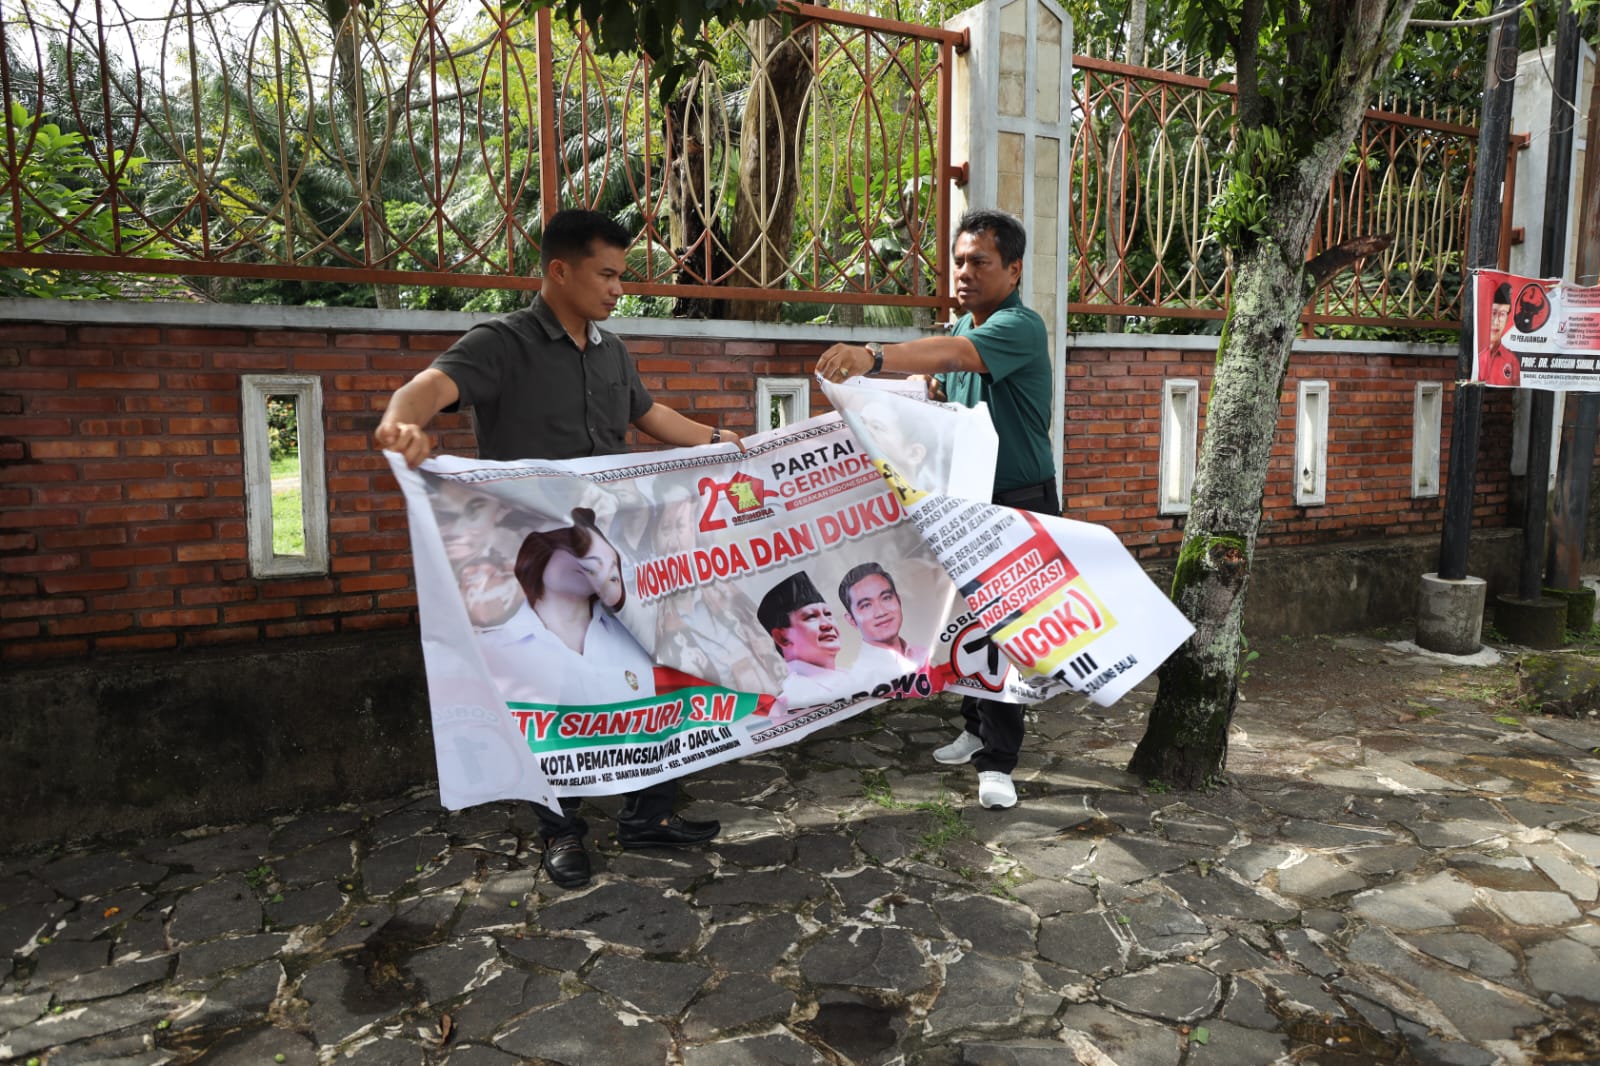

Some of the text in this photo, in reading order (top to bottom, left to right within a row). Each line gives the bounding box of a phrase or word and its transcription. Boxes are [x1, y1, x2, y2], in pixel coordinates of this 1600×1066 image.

[771, 439, 855, 480] PARTAI
[793, 490, 829, 507] GERAKAN
[829, 475, 868, 495] INDONESIA
[636, 492, 908, 601] MOHON DOA DAN DUKU
[955, 530, 992, 560] BERJUANG
[1069, 652, 1098, 680] III
[511, 711, 556, 739] TY
[560, 699, 684, 737] SIANTURI,
[690, 695, 738, 722] S.M
[541, 754, 575, 776] KOTA
[687, 729, 720, 751] DAPIL
[718, 726, 732, 740] III
[569, 775, 597, 787] SELATAN
[615, 769, 640, 781] SIANTAR
[682, 750, 706, 764] SIANTAR
